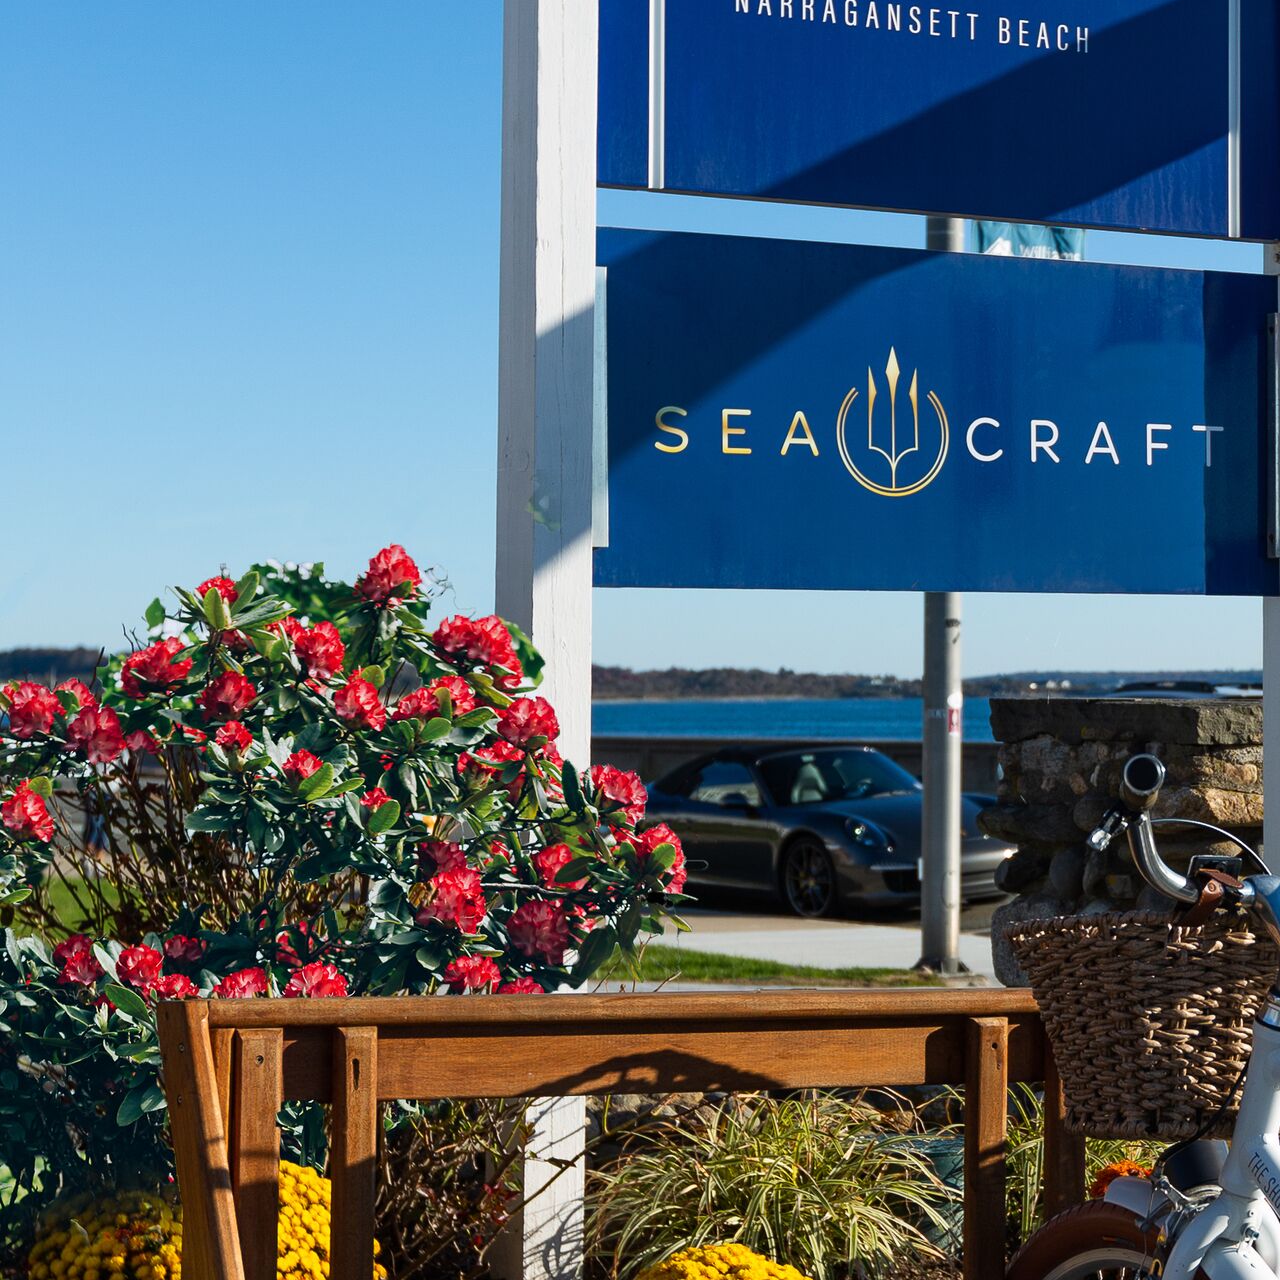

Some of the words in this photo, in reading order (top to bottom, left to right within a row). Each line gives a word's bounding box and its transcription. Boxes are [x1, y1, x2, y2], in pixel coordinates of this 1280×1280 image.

[999, 16, 1090, 54] BEACH
[654, 405, 820, 457] SEA
[965, 416, 1225, 468] CRAFT
[1247, 1151, 1270, 1185] THE
